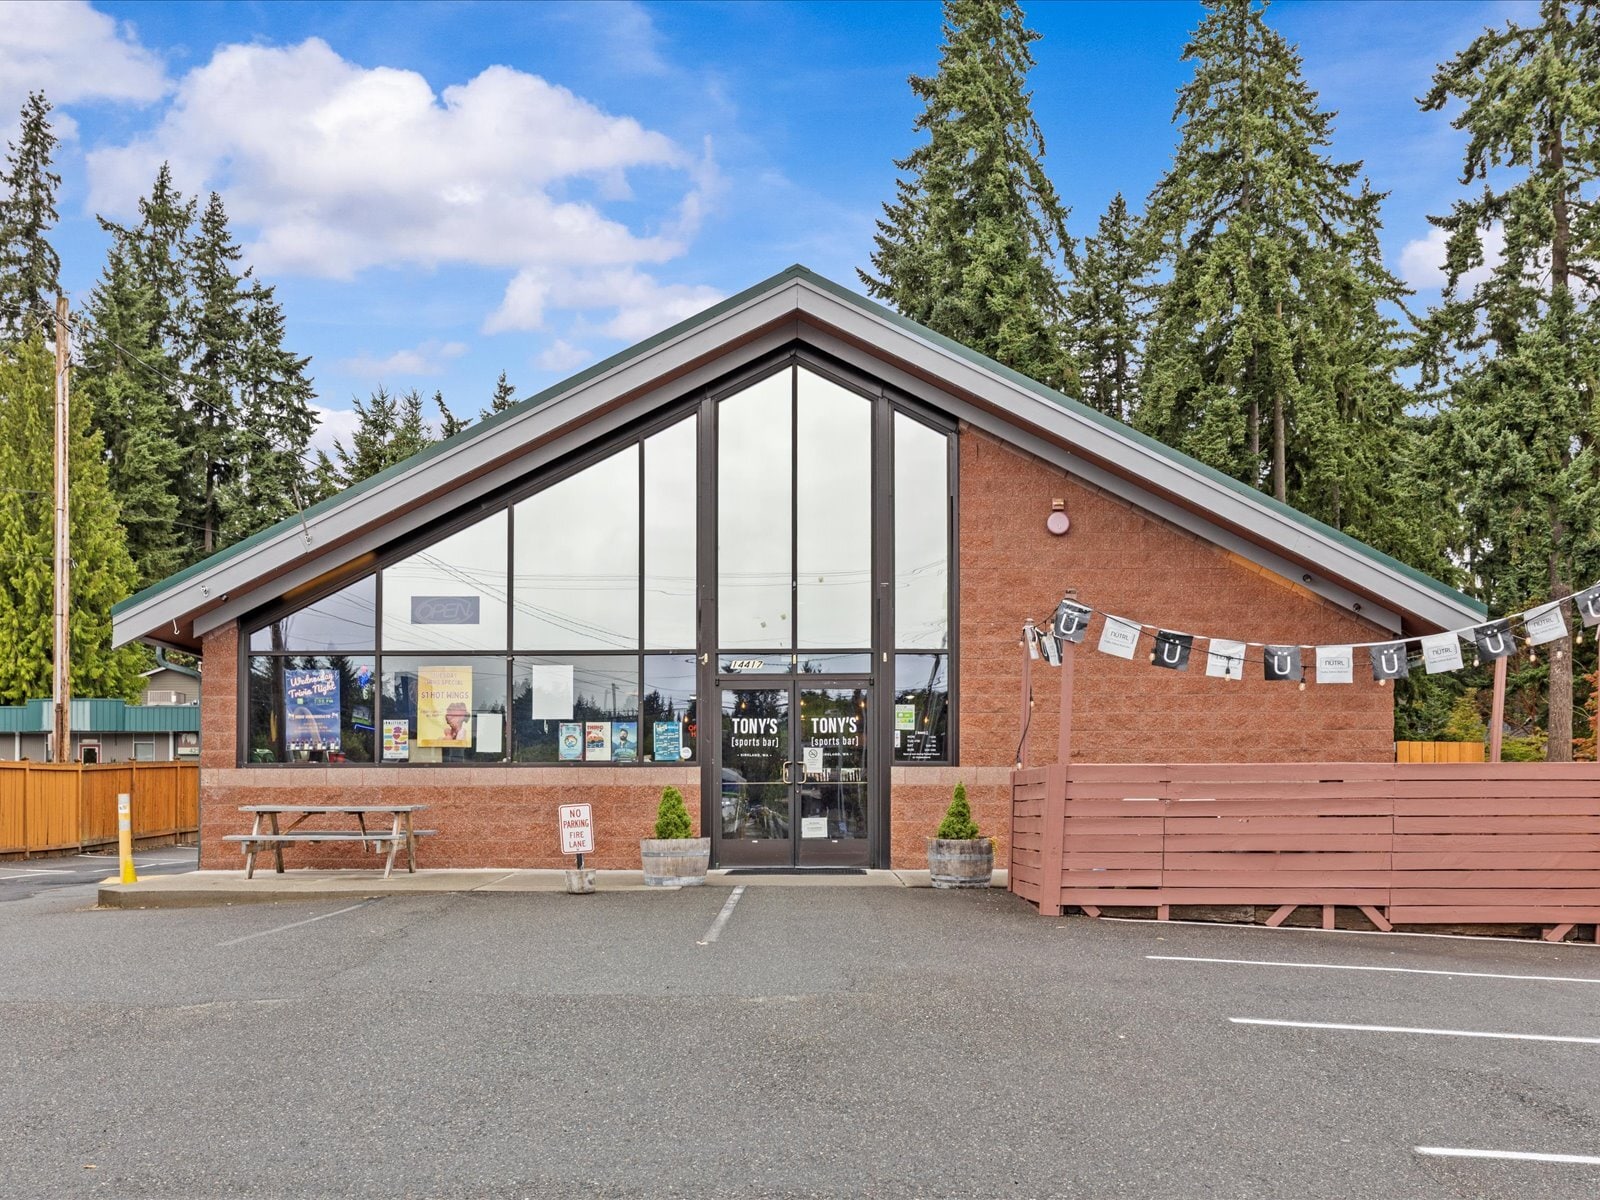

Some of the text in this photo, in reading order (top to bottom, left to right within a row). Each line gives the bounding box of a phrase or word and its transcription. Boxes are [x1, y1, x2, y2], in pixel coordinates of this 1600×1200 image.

[418, 603, 470, 619] OPEN
[1486, 628, 1505, 654] Ü
[1163, 638, 1181, 664] Ü
[732, 660, 763, 669] 14417
[1274, 650, 1291, 676] Ü
[1381, 648, 1399, 674] Ü
[290, 670, 334, 687] Wednesday
[288, 681, 337, 699] Trivia Night
[430, 691, 445, 699] HOT
[446, 691, 470, 699] WINGS
[731, 717, 778, 734] TONY'S
[810, 716, 858, 733] TONY'S
[569, 808, 582, 818] NO
[563, 819, 590, 829] PARKING
[569, 831, 585, 839] FIRE
[569, 840, 586, 849] LANE
